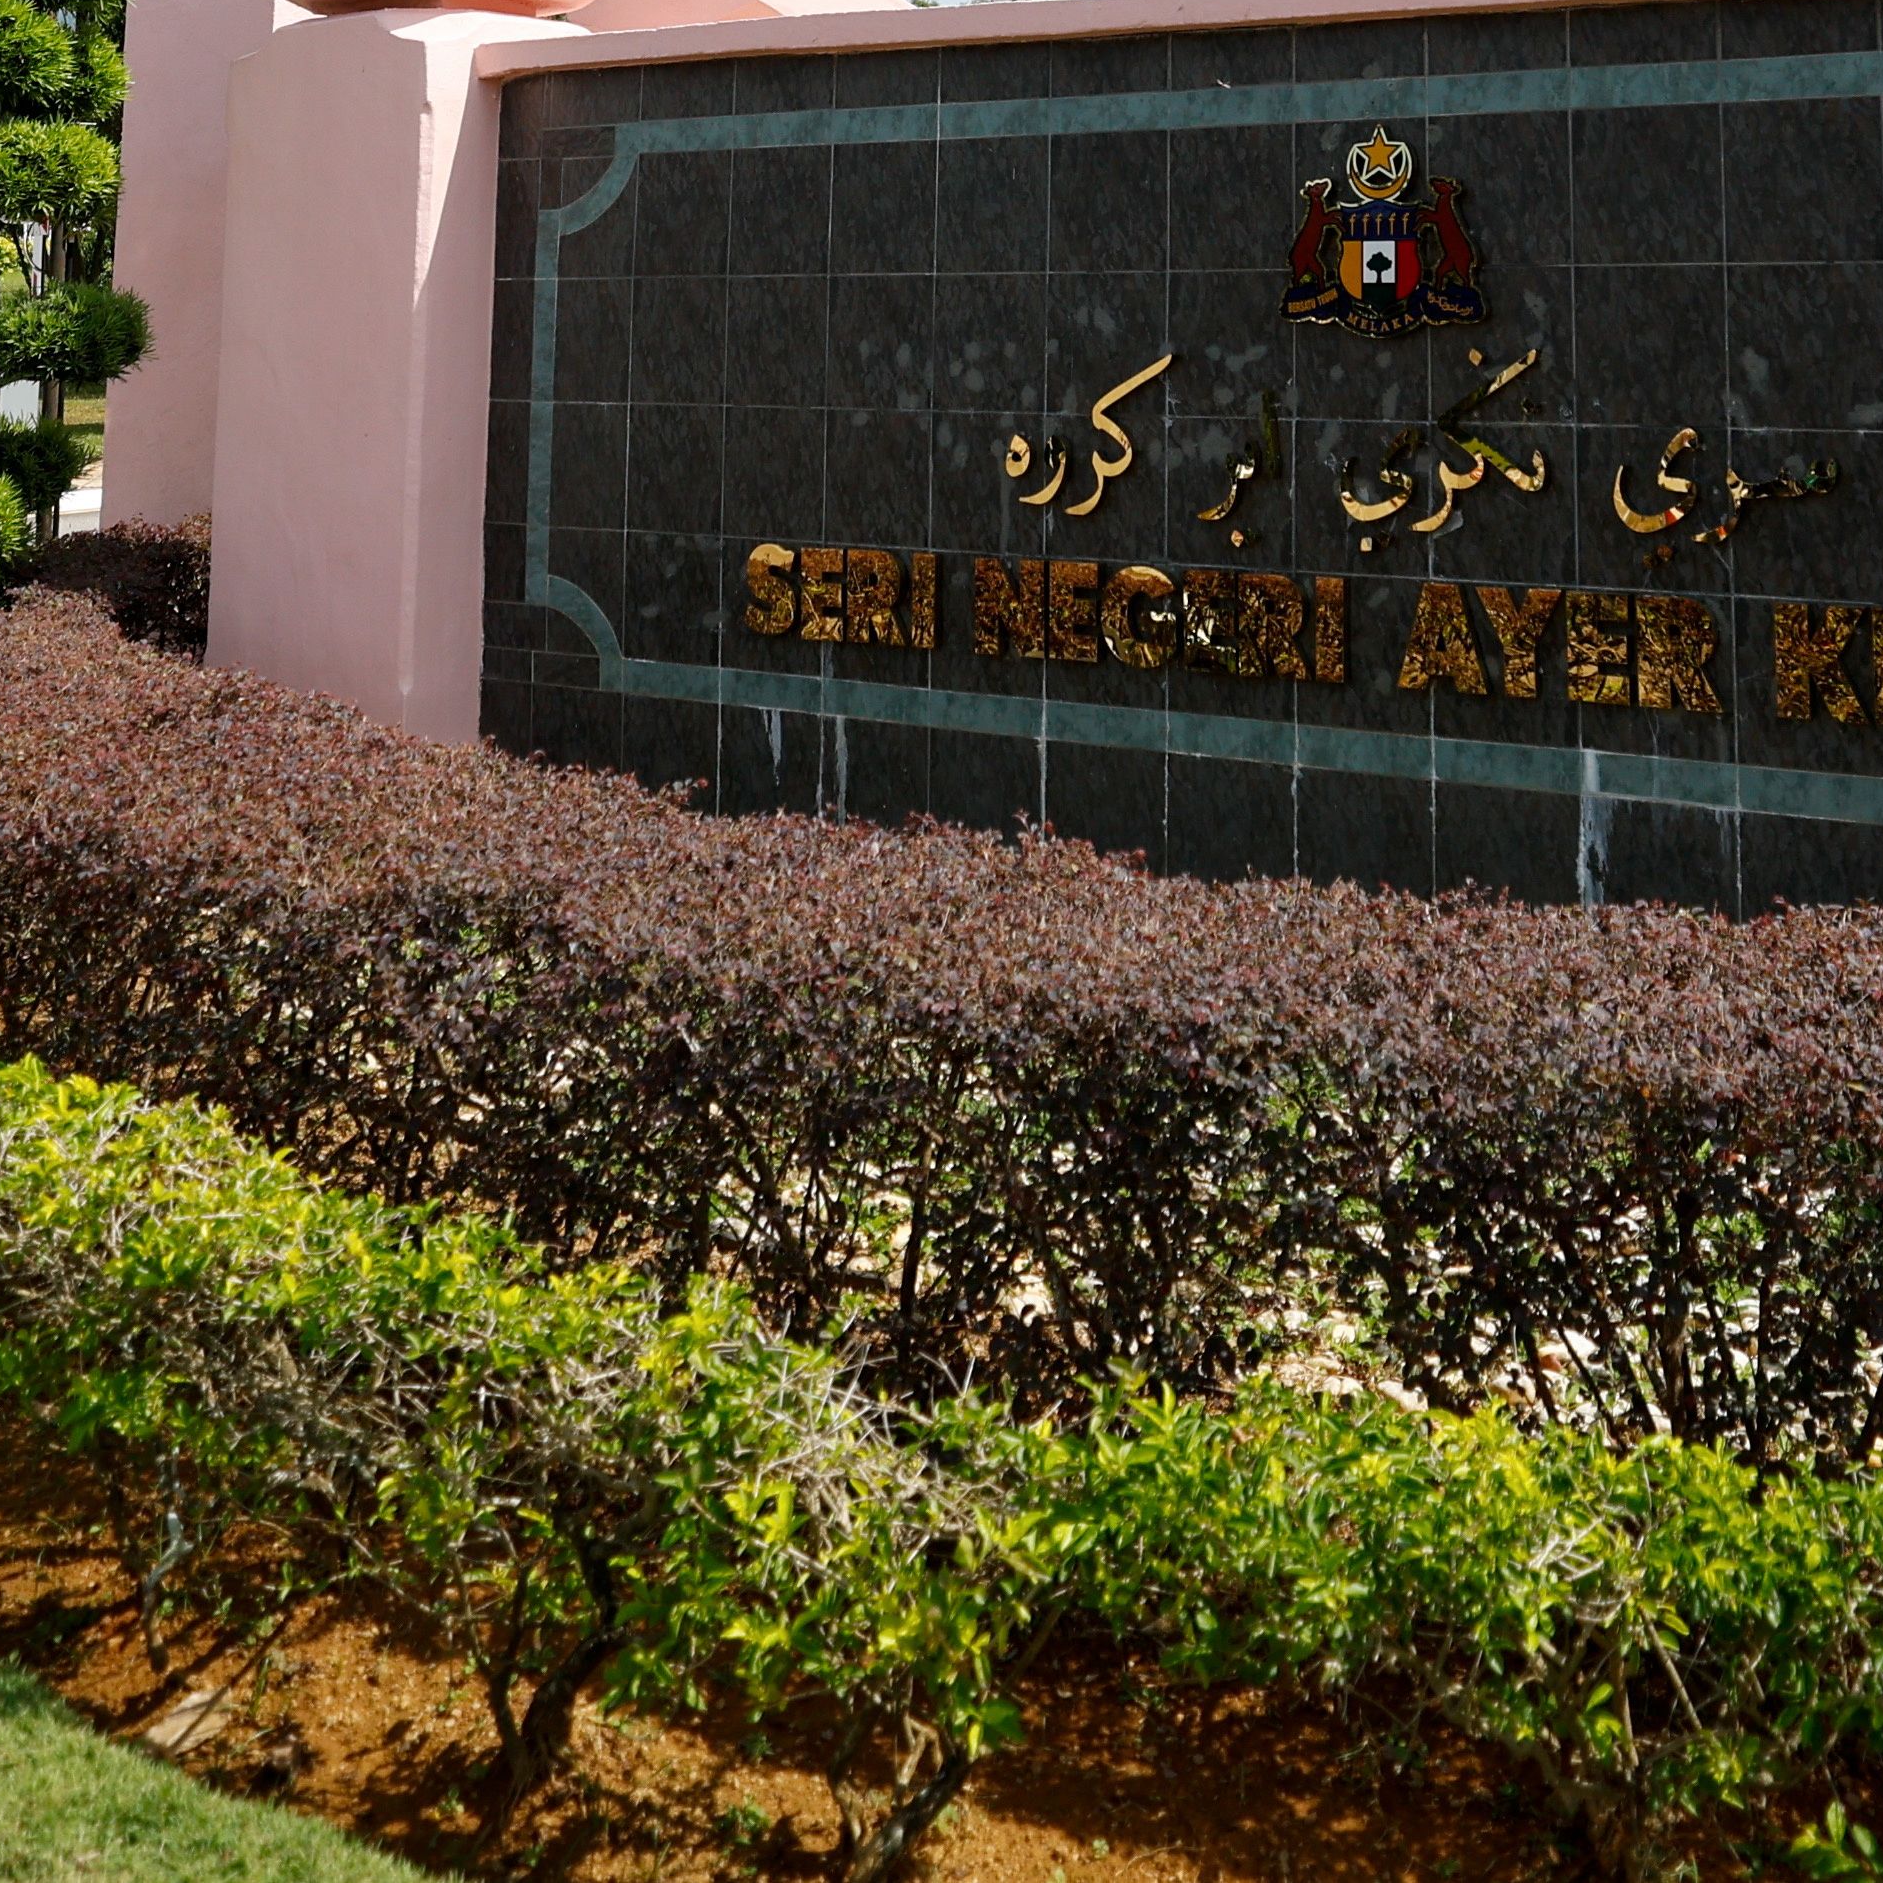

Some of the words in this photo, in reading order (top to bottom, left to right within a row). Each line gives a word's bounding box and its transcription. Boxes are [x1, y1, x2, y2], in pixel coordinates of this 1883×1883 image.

[1347, 313, 1415, 333] MELAKA
[745, 543, 939, 650] SERI
[974, 557, 1347, 685] NEGERI
[1397, 582, 1722, 714] AYER
